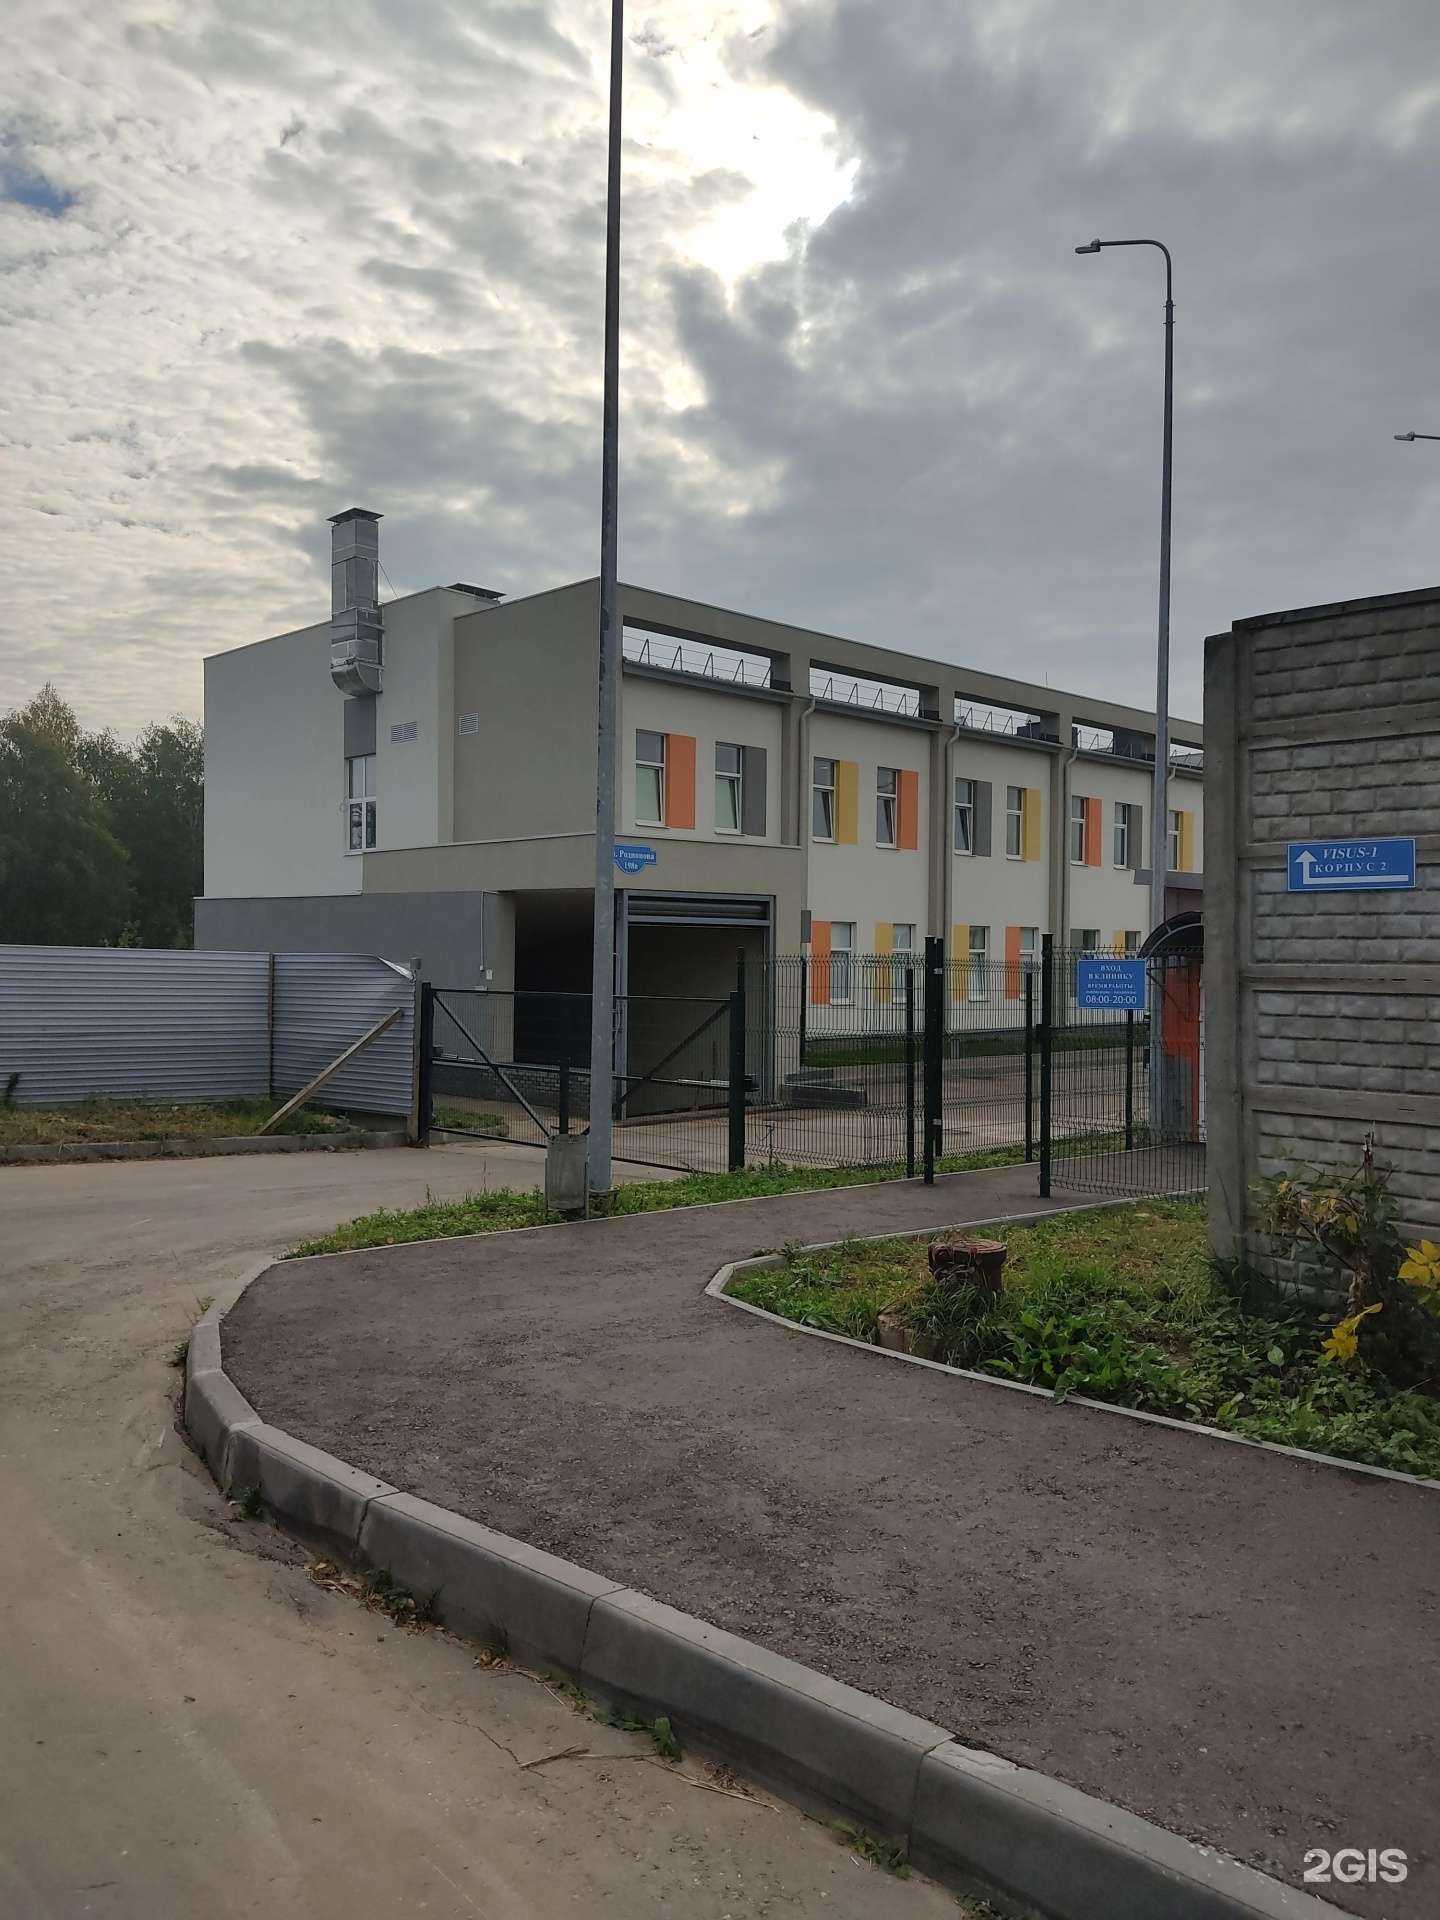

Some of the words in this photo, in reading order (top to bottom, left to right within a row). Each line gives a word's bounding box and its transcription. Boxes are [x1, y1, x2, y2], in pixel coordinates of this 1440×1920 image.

[1322, 846, 1378, 860] VISUS-1
[1315, 862, 1376, 873] КОРПУС
[1379, 861, 1388, 871] 2
[1100, 964, 1121, 973] ВХОД
[1085, 995, 1137, 1004] 08:00-20:00
